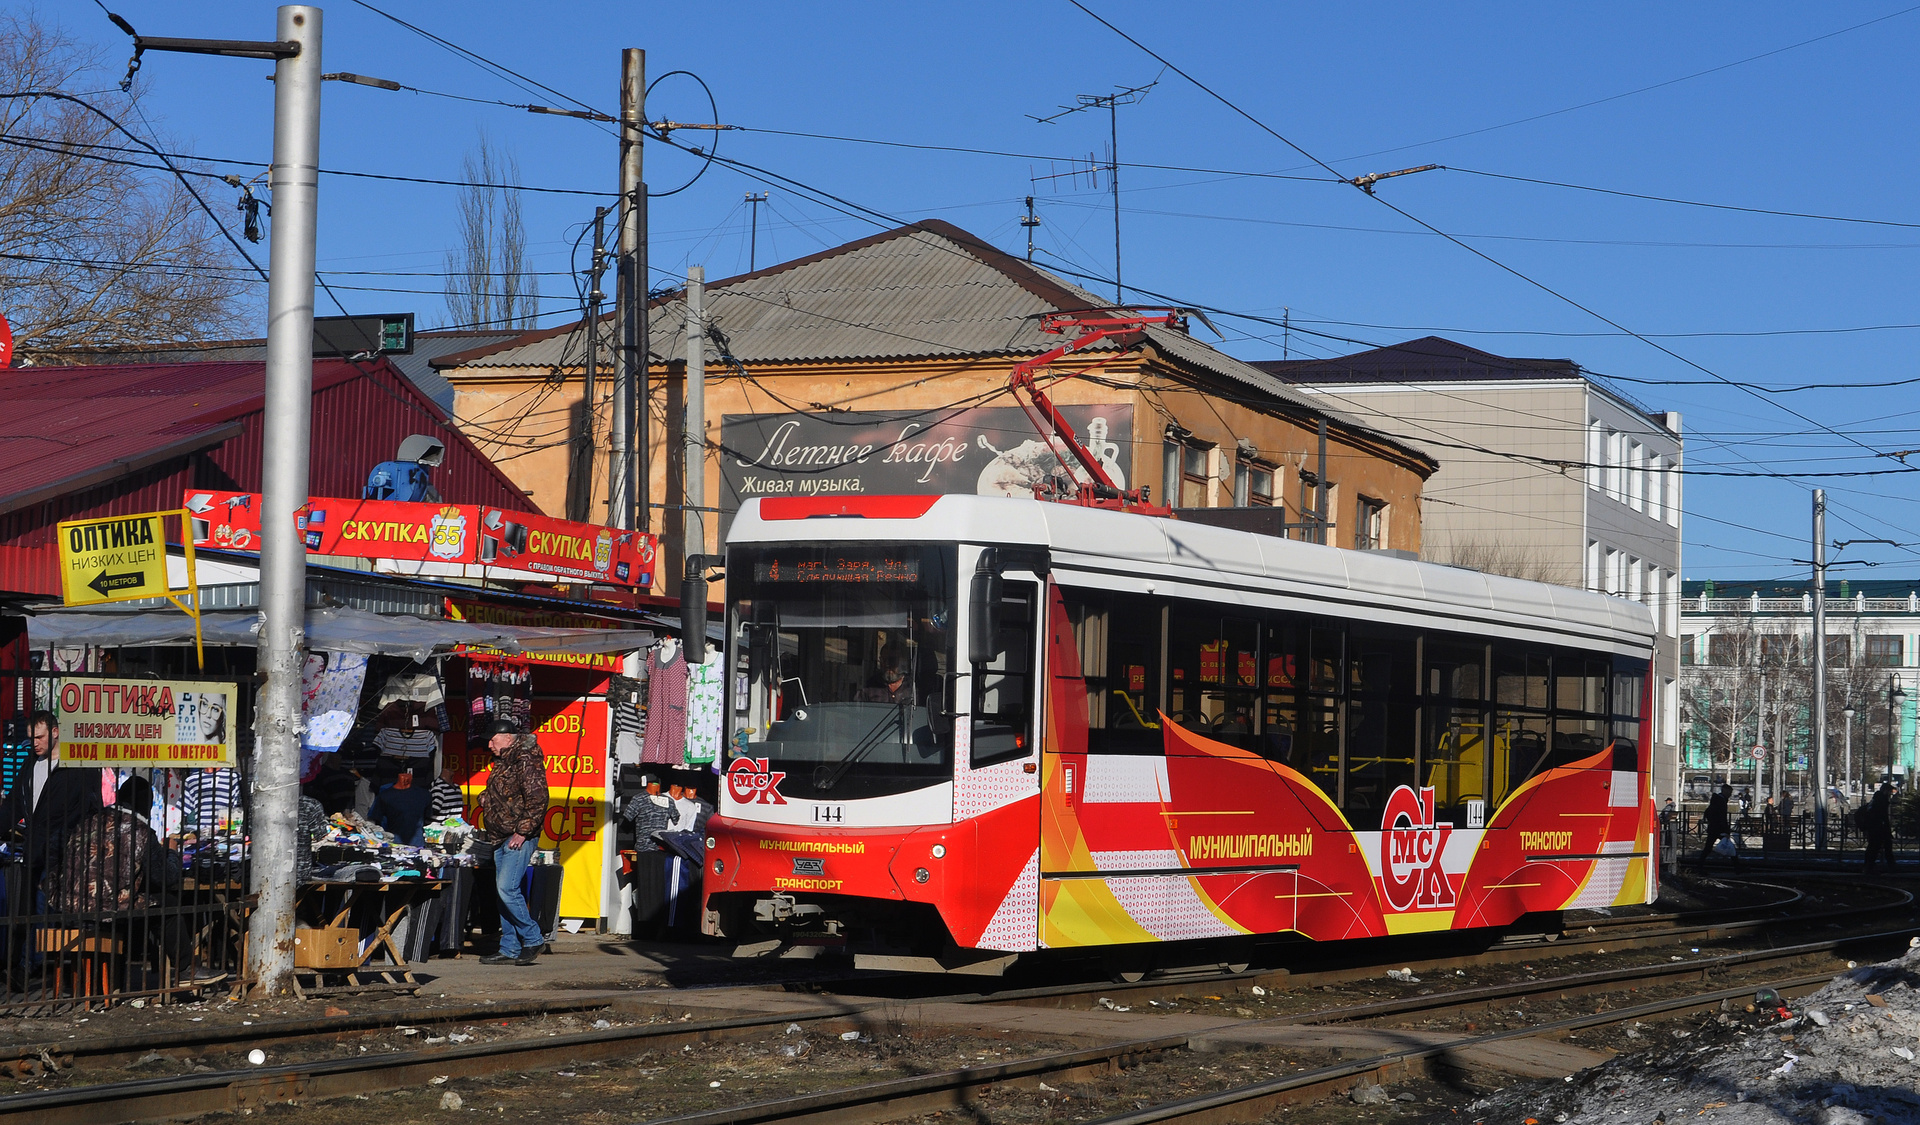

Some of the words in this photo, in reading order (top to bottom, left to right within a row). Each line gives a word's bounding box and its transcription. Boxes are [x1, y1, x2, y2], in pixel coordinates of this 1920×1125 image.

[737, 421, 873, 467] Летнее
[883, 423, 968, 484] кафе
[740, 476, 794, 493] Живая
[799, 477, 865, 496] музыка,
[70, 518, 154, 553] ОПТИКА
[342, 520, 429, 544] СКУПКА
[434, 525, 460, 545] 55
[529, 530, 593, 561] СКУПКА
[597, 542, 609, 562] 55
[72, 552, 124, 570] НИЗКИХ
[128, 549, 155, 565] ЦЕН
[109, 576, 138, 586] МЕТРОВ
[61, 683, 176, 715] ОПТИКА
[74, 722, 132, 739] НИЗКИХ
[135, 724, 162, 741] ЦЕН
[69, 744, 98, 760] ВХОД
[105, 745, 118, 758] НА
[123, 745, 159, 759] РЫНОК
[168, 745, 178, 759] 10
[181, 745, 219, 759] МЕТРОВ
[1753, 749, 1764, 757] 40
[813, 806, 842, 822] 144
[1469, 802, 1483, 825] 144
[759, 839, 865, 854] МУНИЦИПАЛЬНЫЙ
[1190, 827, 1312, 859] МУНИЦИПАЛЬНЫЙ
[1520, 831, 1572, 850] ТРАНСПОРТ
[774, 877, 843, 890] ТРАНСПОРТ
